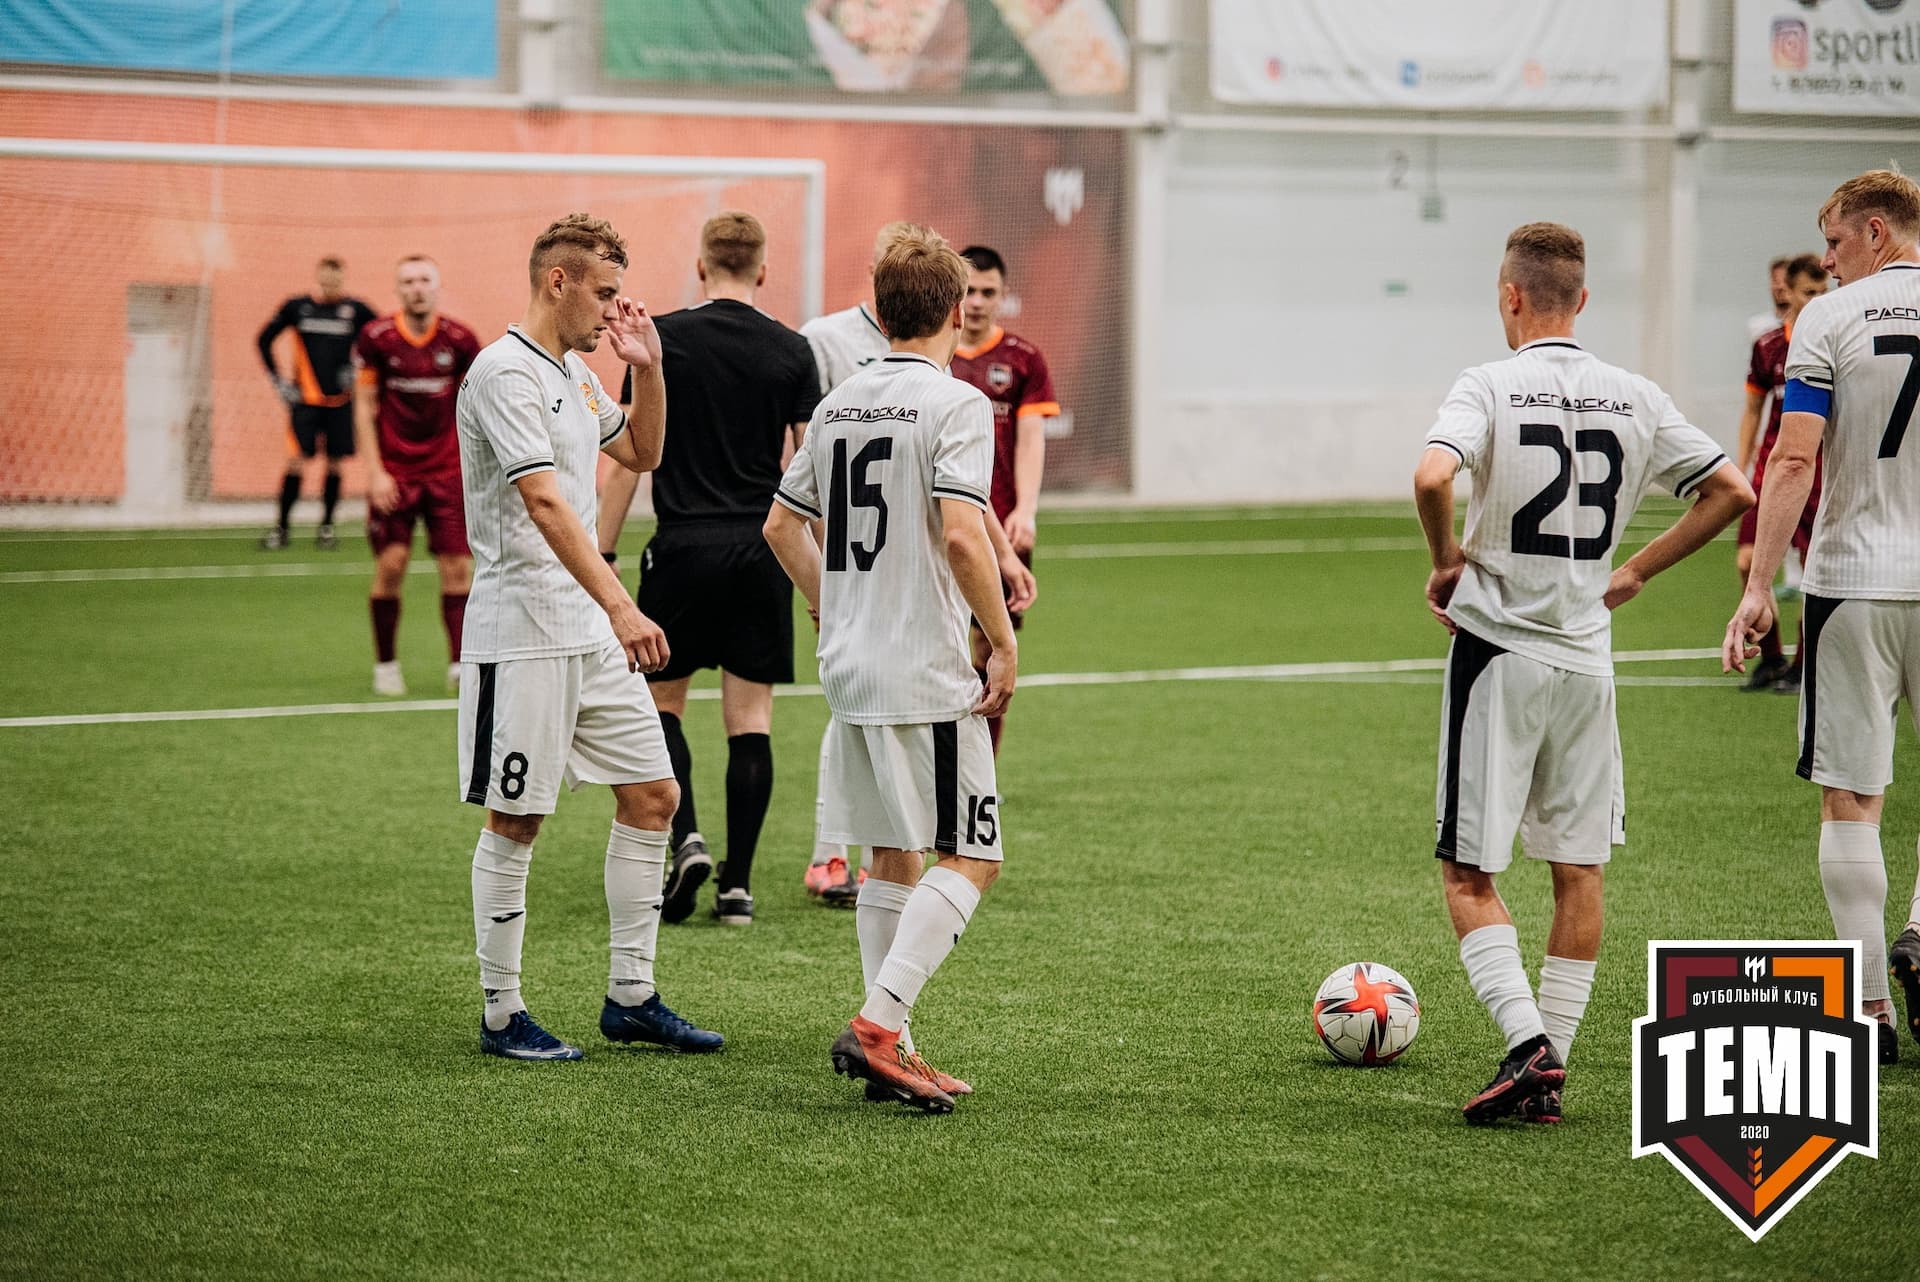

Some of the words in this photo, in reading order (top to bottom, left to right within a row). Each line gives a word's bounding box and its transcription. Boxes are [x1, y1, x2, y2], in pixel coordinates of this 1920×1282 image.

[1865, 307, 1920, 322] РАСП
[1874, 334, 1920, 459] 7
[826, 437, 893, 572] 15
[1511, 424, 1624, 560] 23
[501, 751, 529, 800] 8
[966, 795, 997, 846] 15
